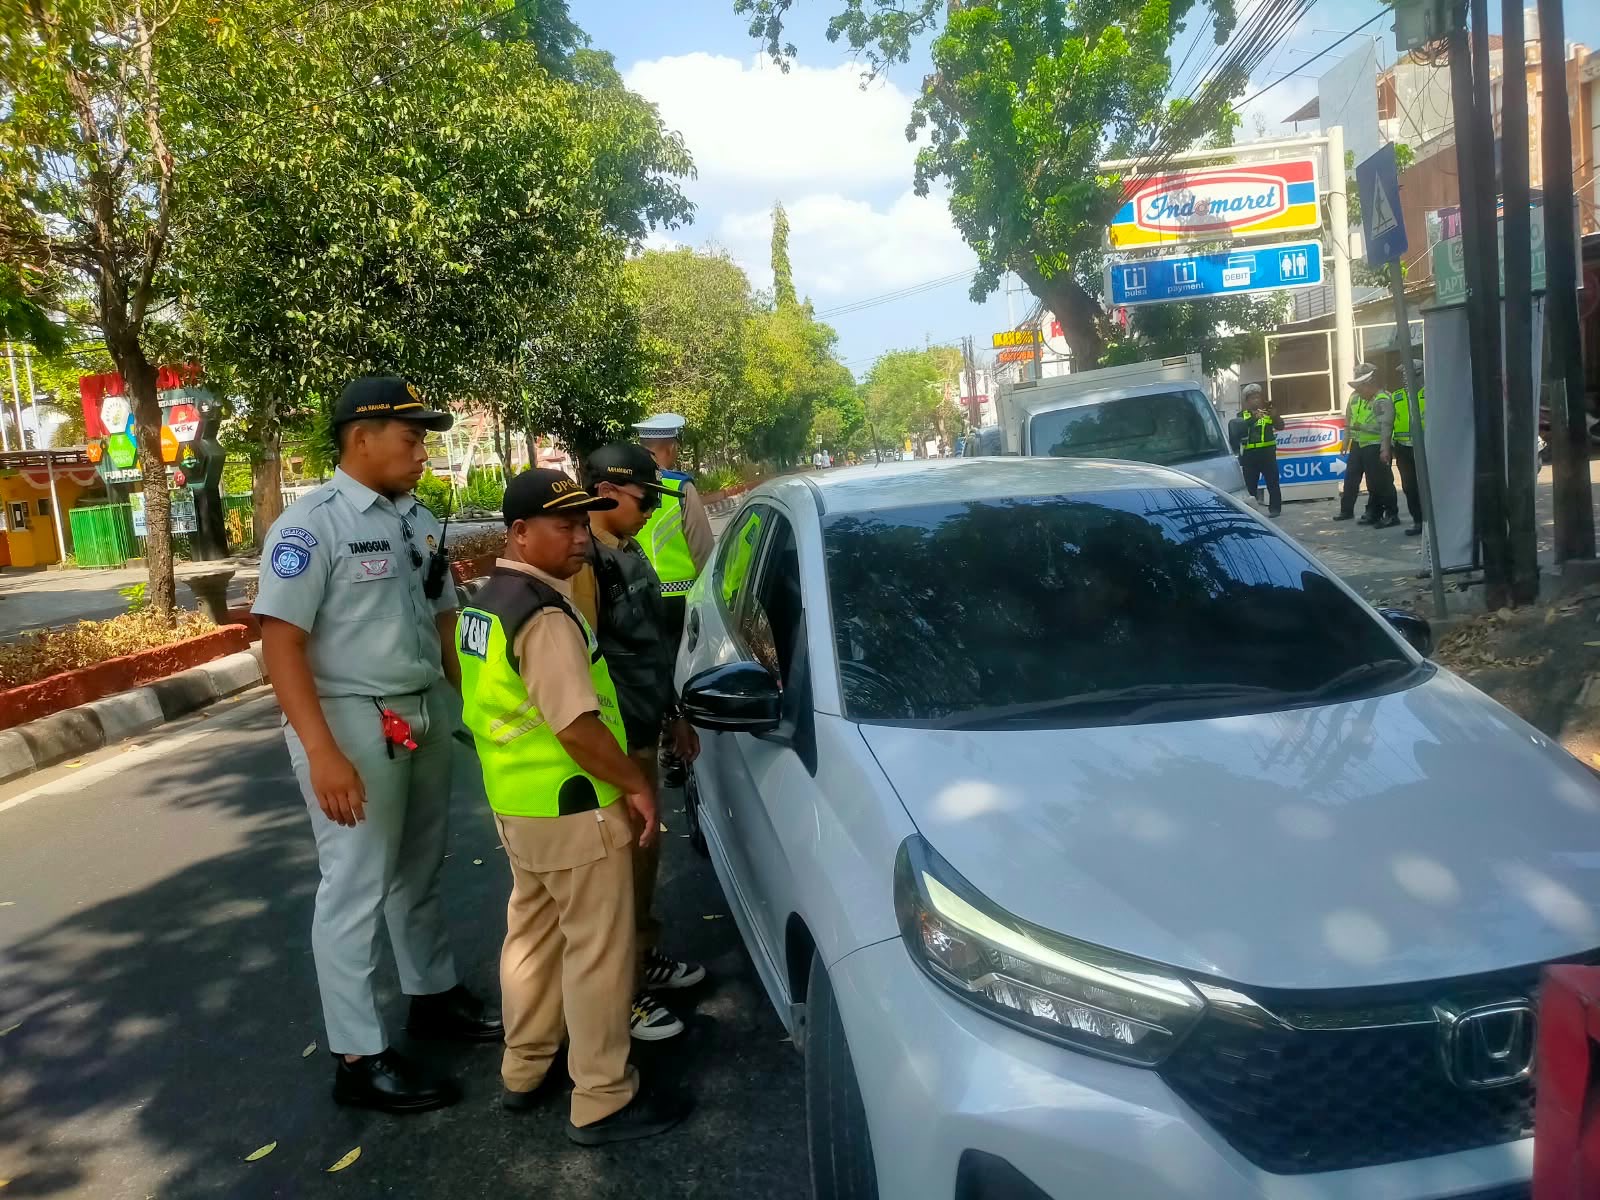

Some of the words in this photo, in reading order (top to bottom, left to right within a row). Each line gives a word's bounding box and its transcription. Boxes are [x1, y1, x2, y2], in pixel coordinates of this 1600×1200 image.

[1146, 186, 1276, 221] Indomaret
[1225, 272, 1249, 281] DEBIT
[1167, 282, 1204, 294] payment
[1440, 276, 1465, 295] LAPT
[1124, 289, 1147, 298] pulsa
[1280, 462, 1323, 479] SUK
[348, 540, 391, 554] TANGGUH
